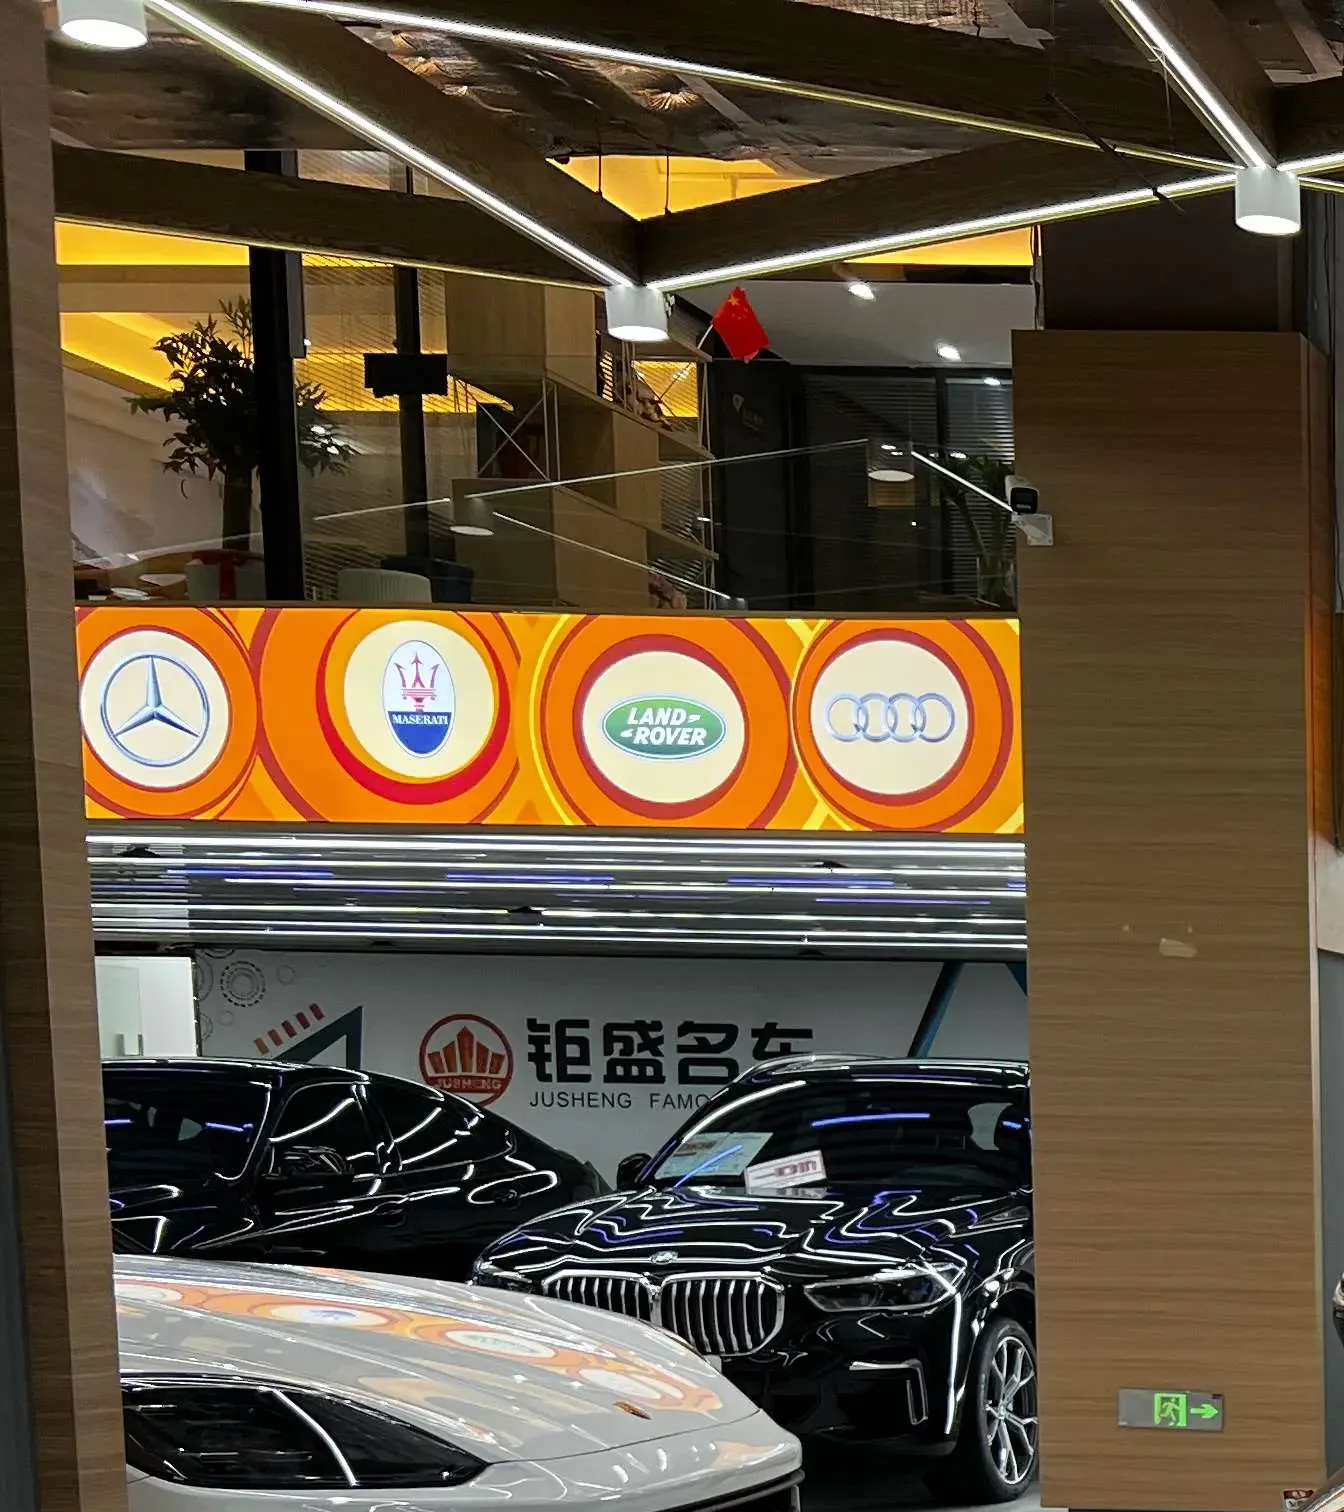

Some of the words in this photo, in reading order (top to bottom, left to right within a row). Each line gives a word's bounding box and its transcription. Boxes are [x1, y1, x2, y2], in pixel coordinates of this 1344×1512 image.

[391, 713, 449, 725] MASERATI
[627, 706, 687, 726] LAND
[632, 726, 708, 746] ROVER
[529, 1091, 632, 1109] JUSHENG
[649, 1093, 712, 1110] FAMO
